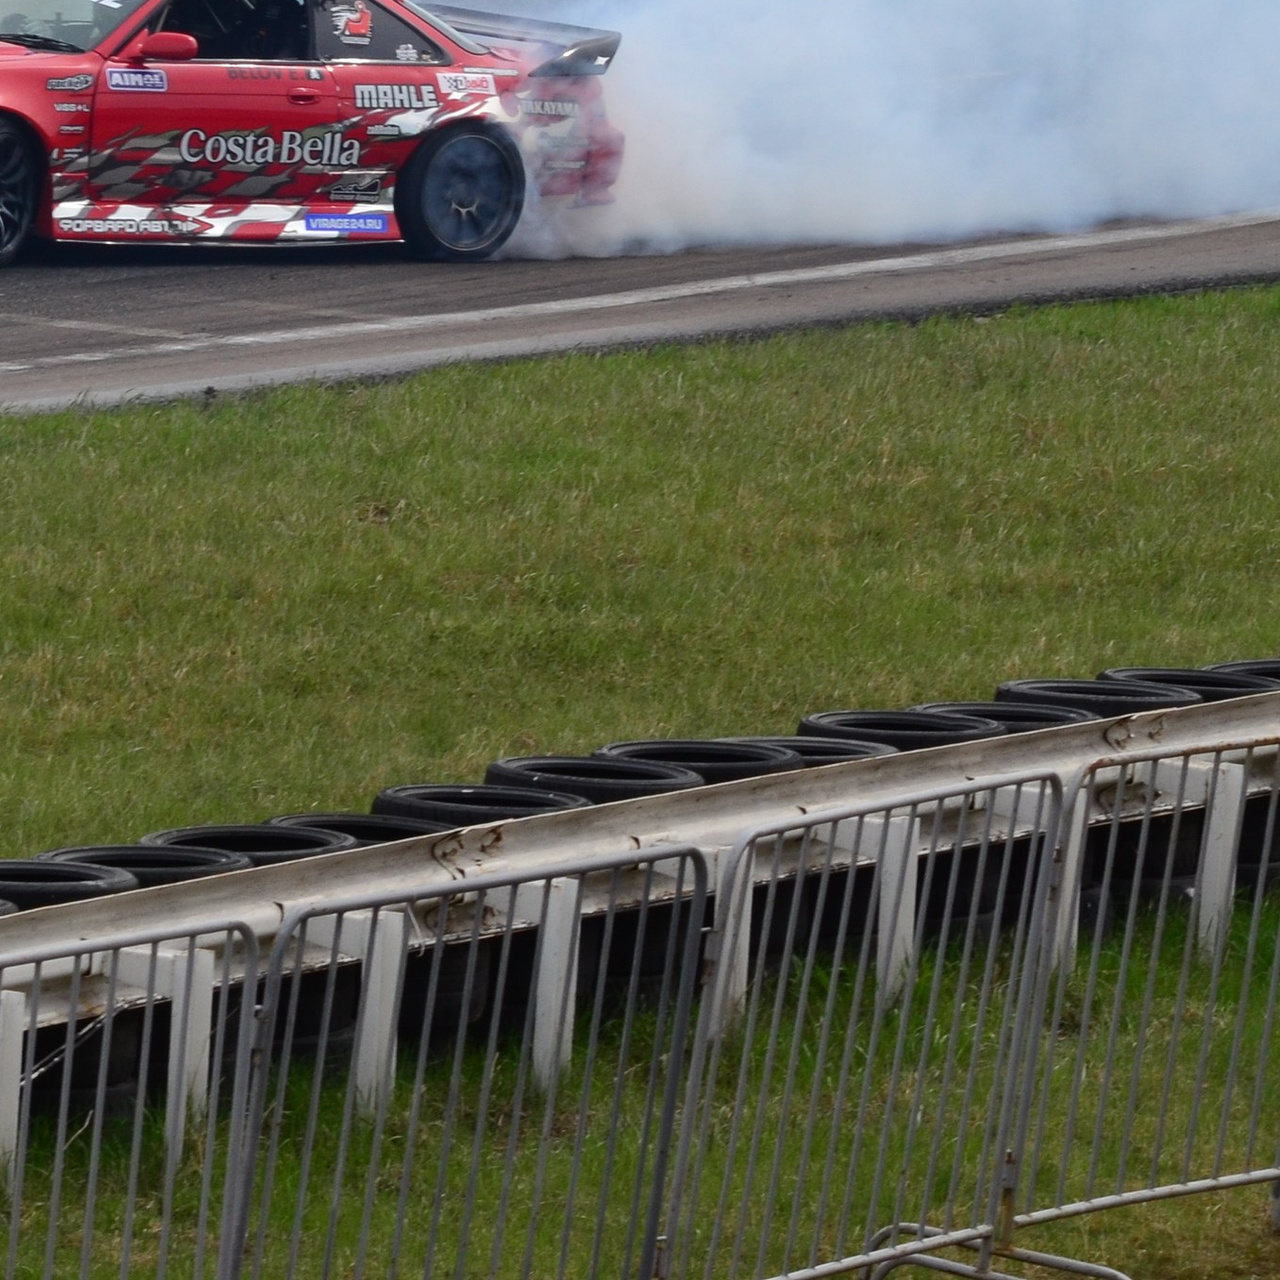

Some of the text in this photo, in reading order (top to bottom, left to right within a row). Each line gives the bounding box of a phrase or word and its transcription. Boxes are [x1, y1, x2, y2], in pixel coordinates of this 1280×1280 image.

[111, 73, 163, 87] AIMOL
[355, 84, 437, 108] MAHLE
[180, 129, 360, 165] Costa Bella
[309, 218, 383, 230] VIRAGE24.RU
